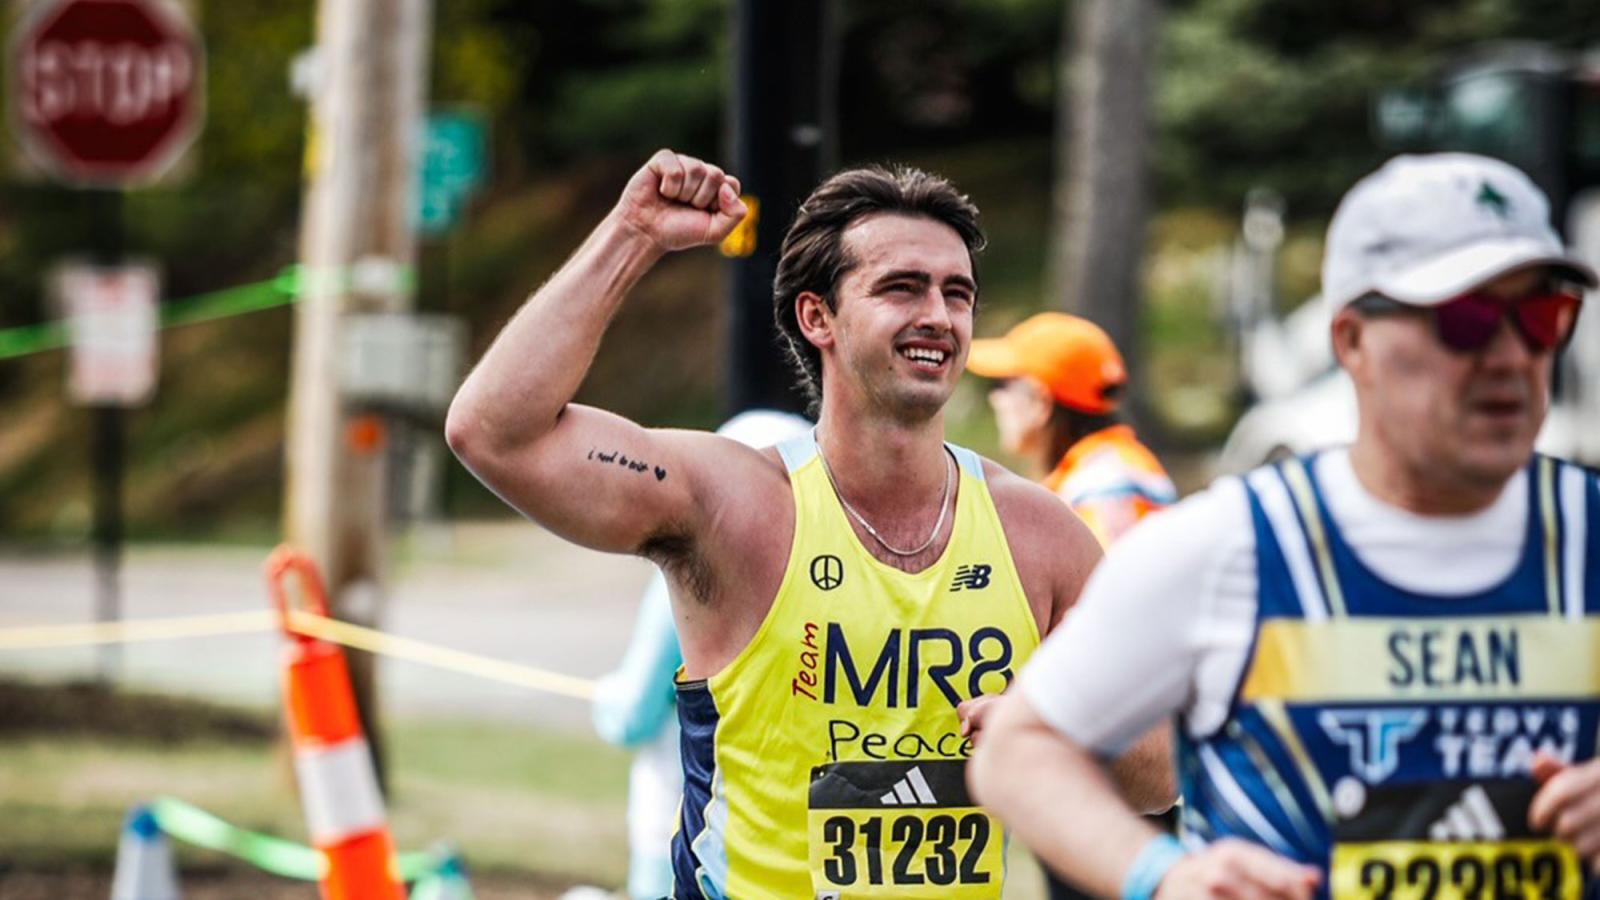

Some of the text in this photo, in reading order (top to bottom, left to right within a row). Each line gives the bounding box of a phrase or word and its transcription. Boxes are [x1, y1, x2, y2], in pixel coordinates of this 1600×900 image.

[31, 42, 191, 121] STOP
[792, 622, 819, 701] Team
[823, 621, 1014, 709] MR8
[1386, 627, 1520, 687] SEAN
[829, 719, 975, 762] Peace
[824, 812, 990, 886] 31232
